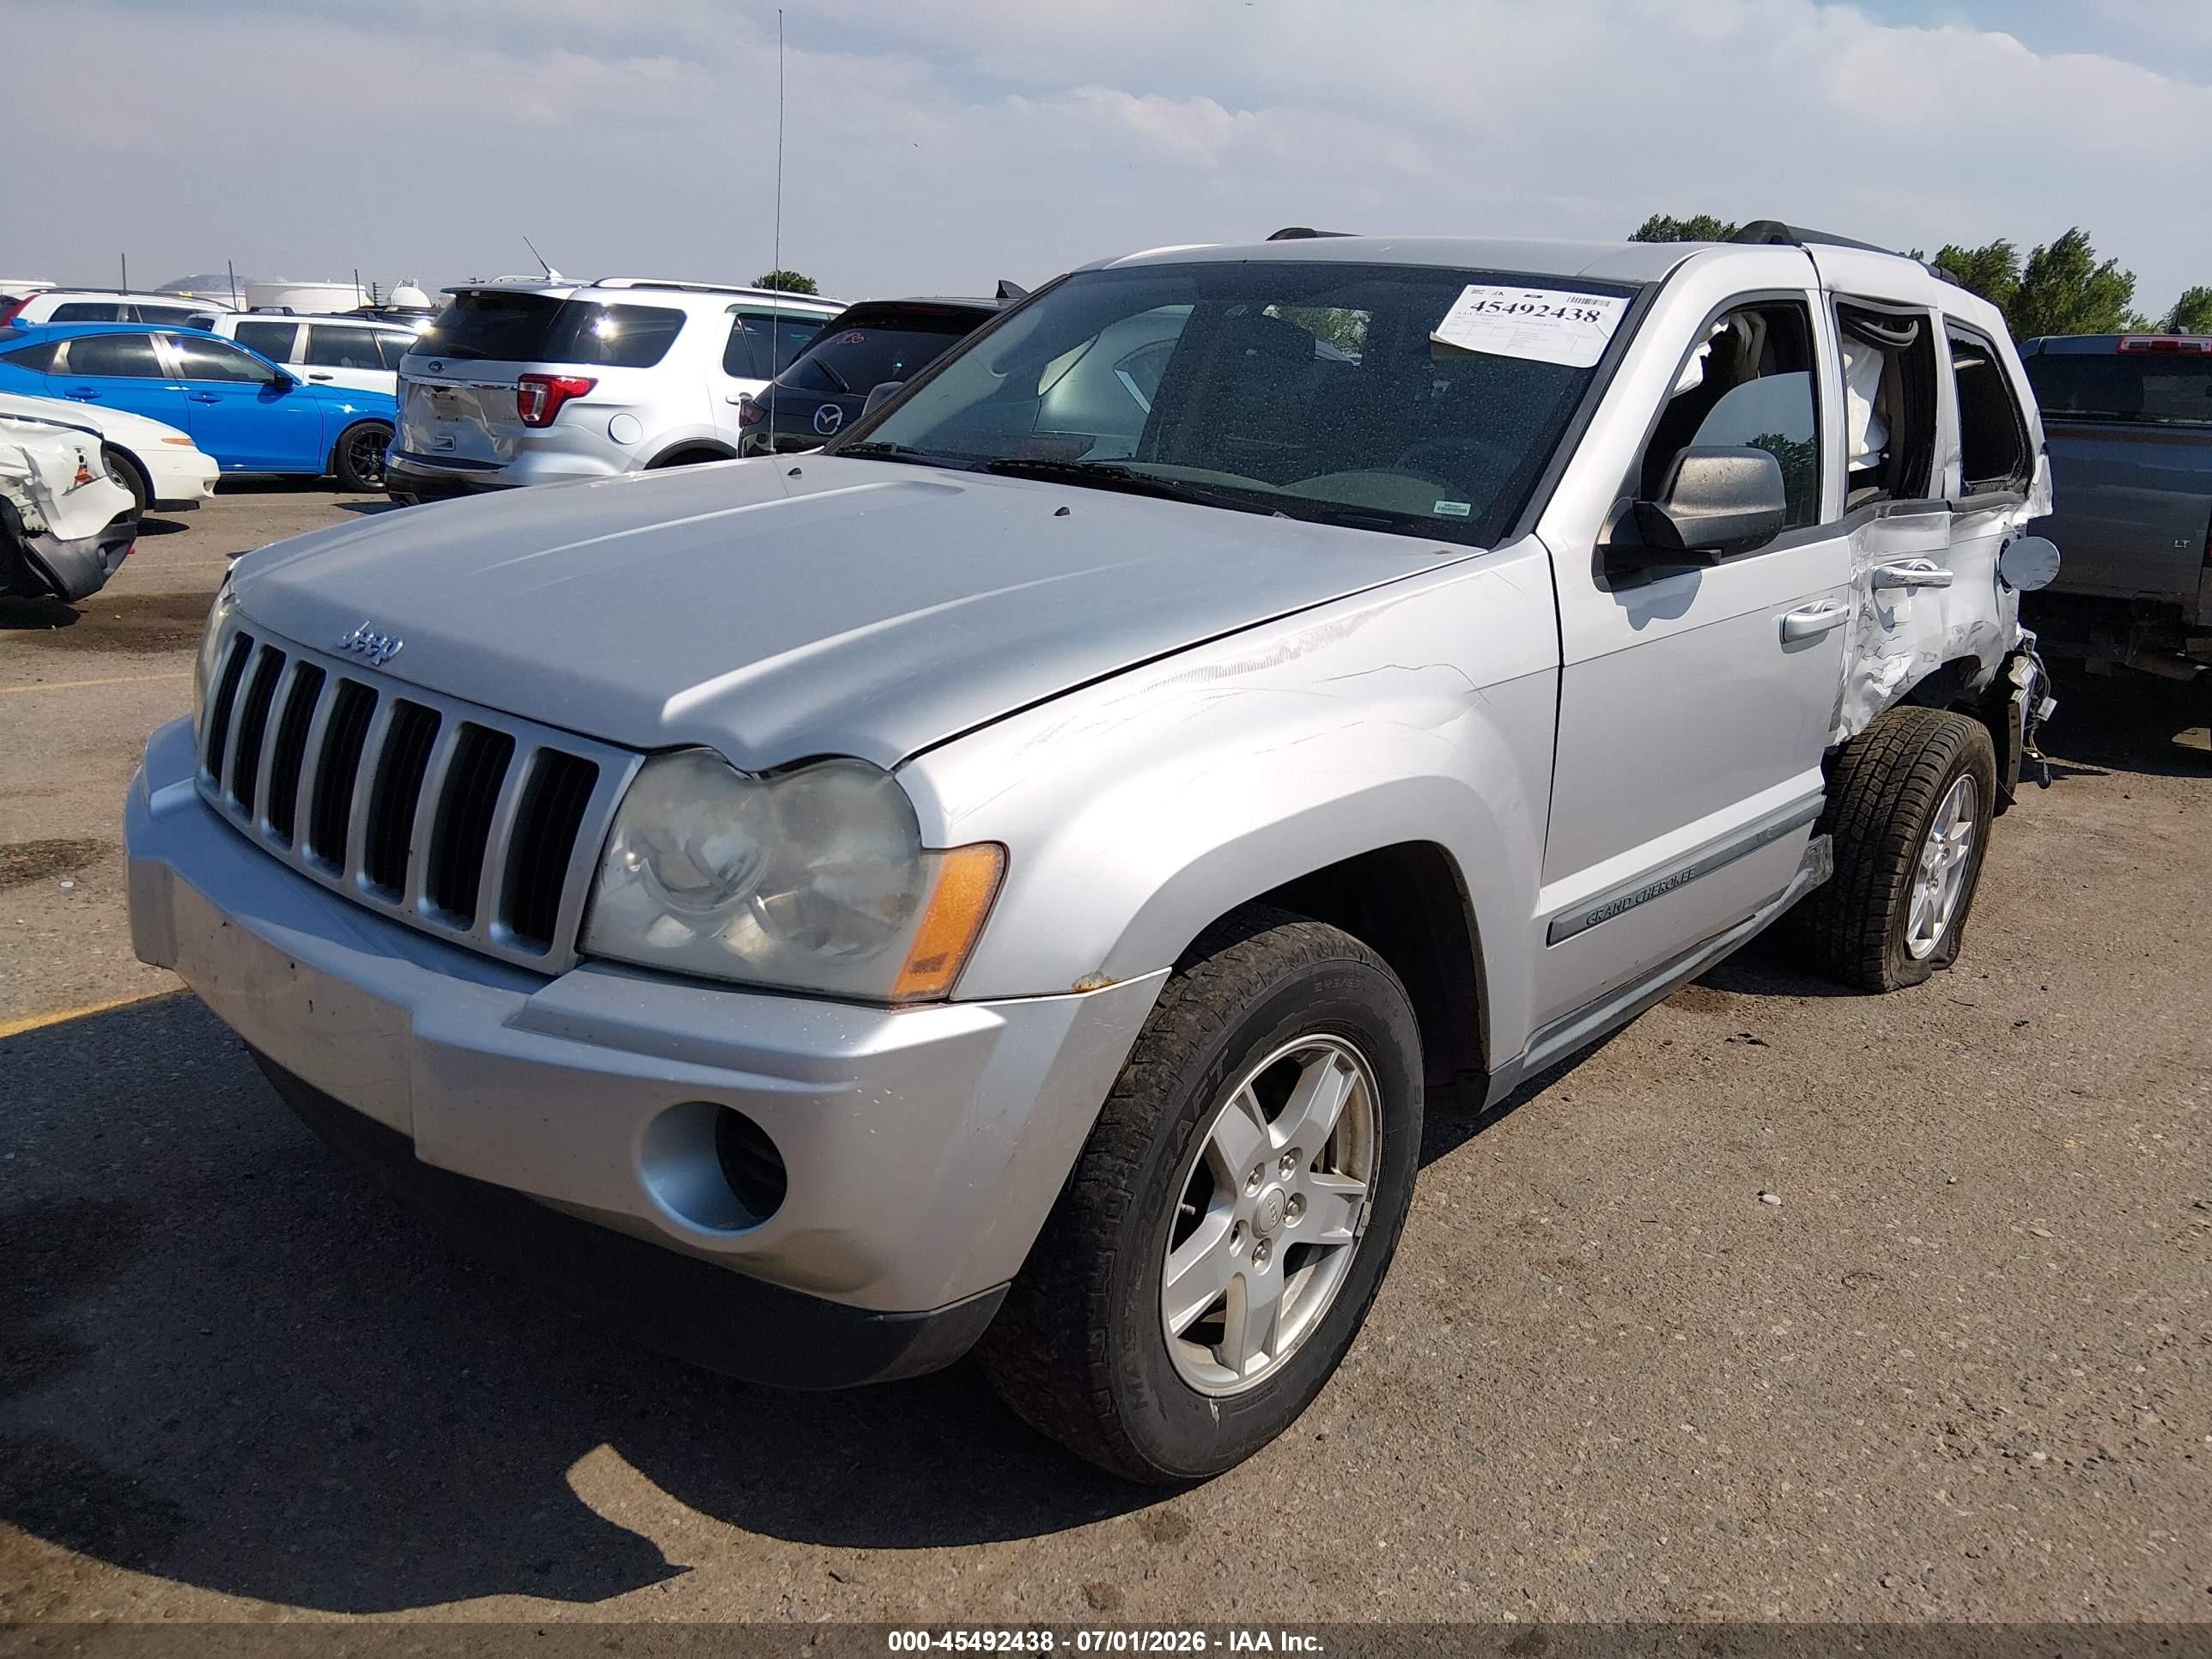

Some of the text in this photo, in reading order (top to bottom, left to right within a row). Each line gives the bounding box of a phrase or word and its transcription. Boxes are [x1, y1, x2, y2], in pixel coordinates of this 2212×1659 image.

[1470, 300, 1601, 324] 45492438
[2174, 539, 2191, 549] LT
[337, 619, 404, 666] Jeep
[1586, 866, 1697, 927] GRAND CHEROKEE
